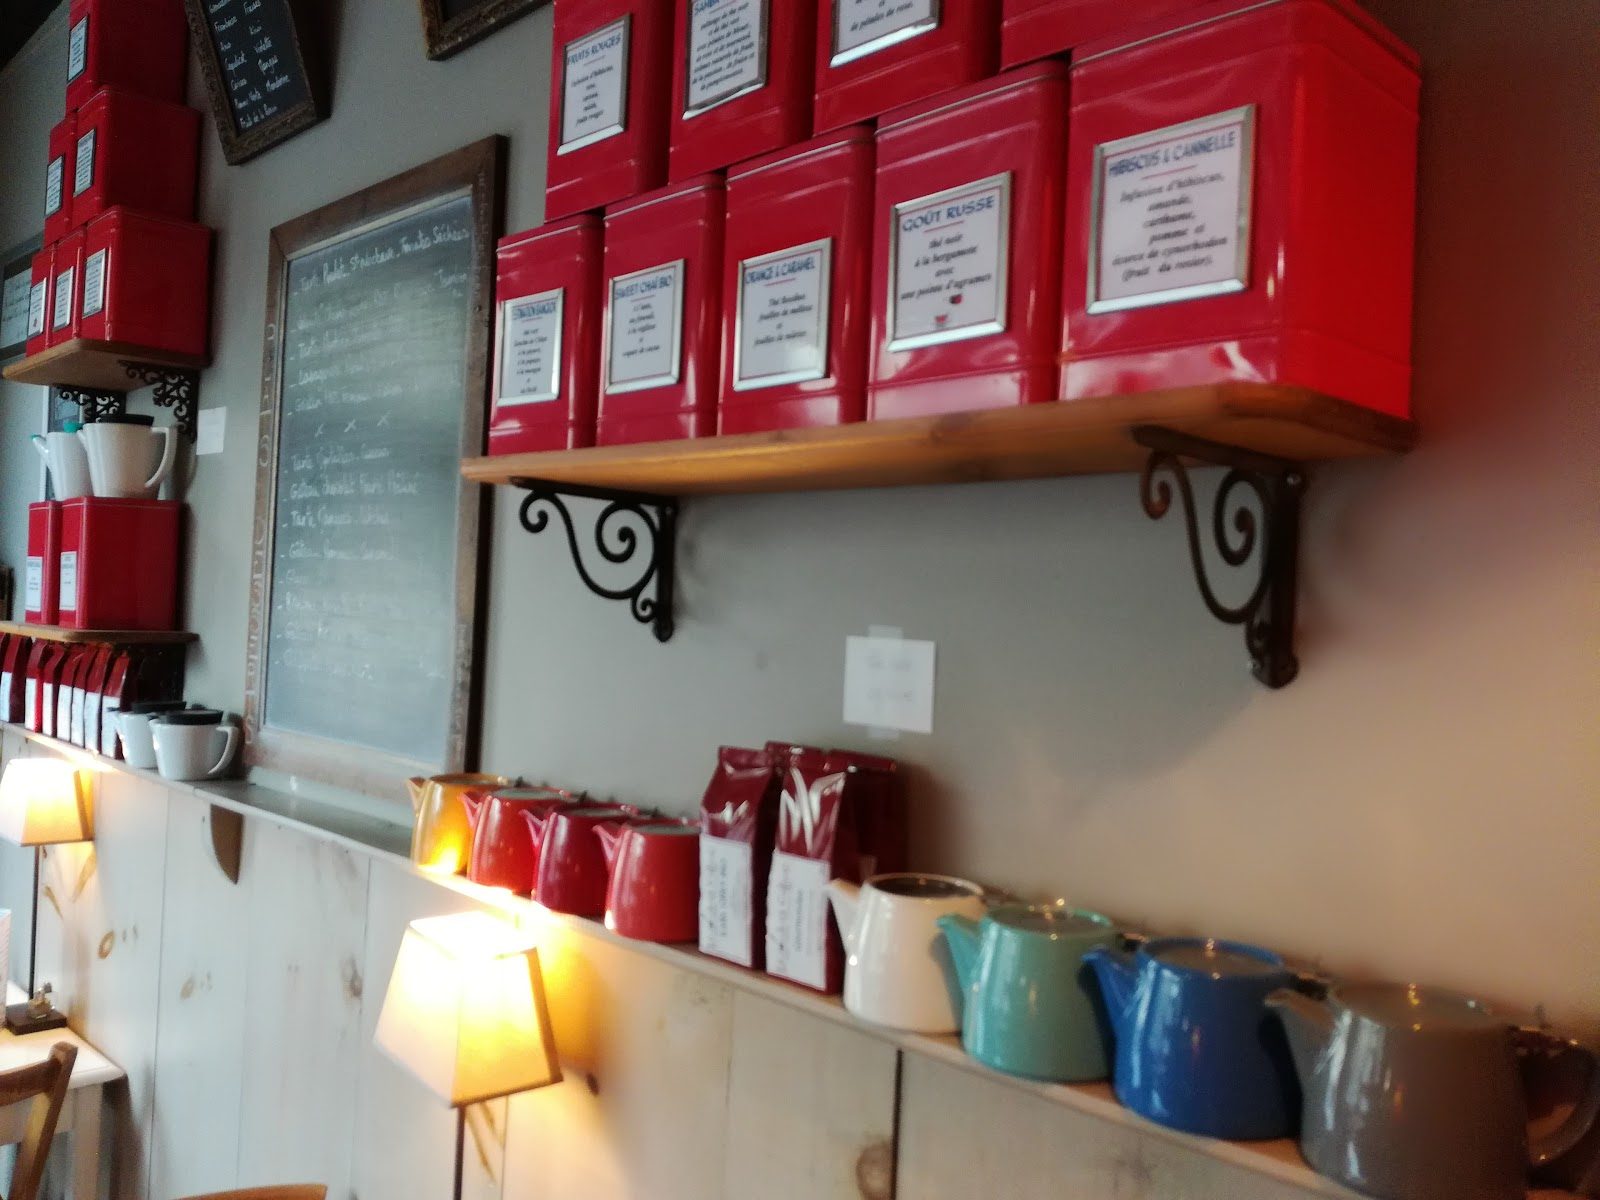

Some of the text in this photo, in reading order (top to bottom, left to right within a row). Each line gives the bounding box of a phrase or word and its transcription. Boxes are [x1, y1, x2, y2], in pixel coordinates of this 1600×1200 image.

[566, 33, 621, 66] FRUITS ROUGES
[1109, 149, 1159, 177] HIBISCUS
[1174, 130, 1237, 161] CANNELLE
[901, 195, 995, 233] GOÛT RUSSE
[928, 233, 963, 249] thé noir
[1195, 225, 1205, 234] et
[1147, 249, 1158, 259] de
[745, 265, 773, 285] ORANGE
[781, 255, 816, 277] CARAMEL
[614, 282, 639, 300] SWEET
